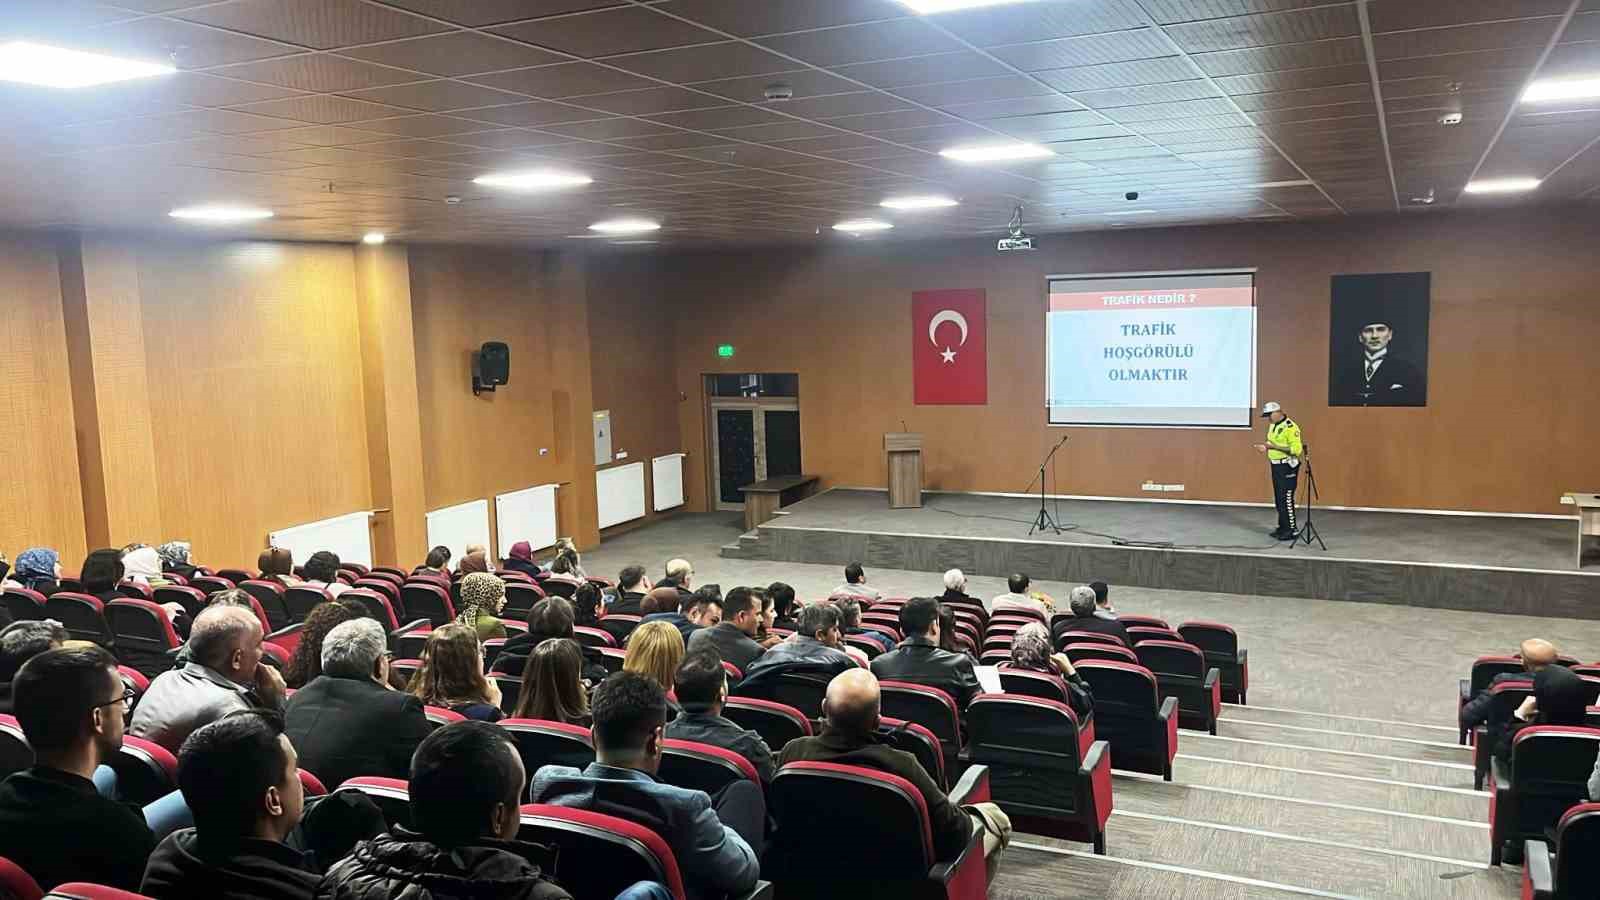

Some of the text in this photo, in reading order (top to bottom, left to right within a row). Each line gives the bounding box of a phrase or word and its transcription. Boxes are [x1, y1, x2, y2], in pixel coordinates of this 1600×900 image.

[1120, 321, 1176, 336] TRAFİK
[1103, 344, 1193, 361] HOŞGÖRÜLÜ
[1108, 368, 1189, 381] OLMAKTIR
